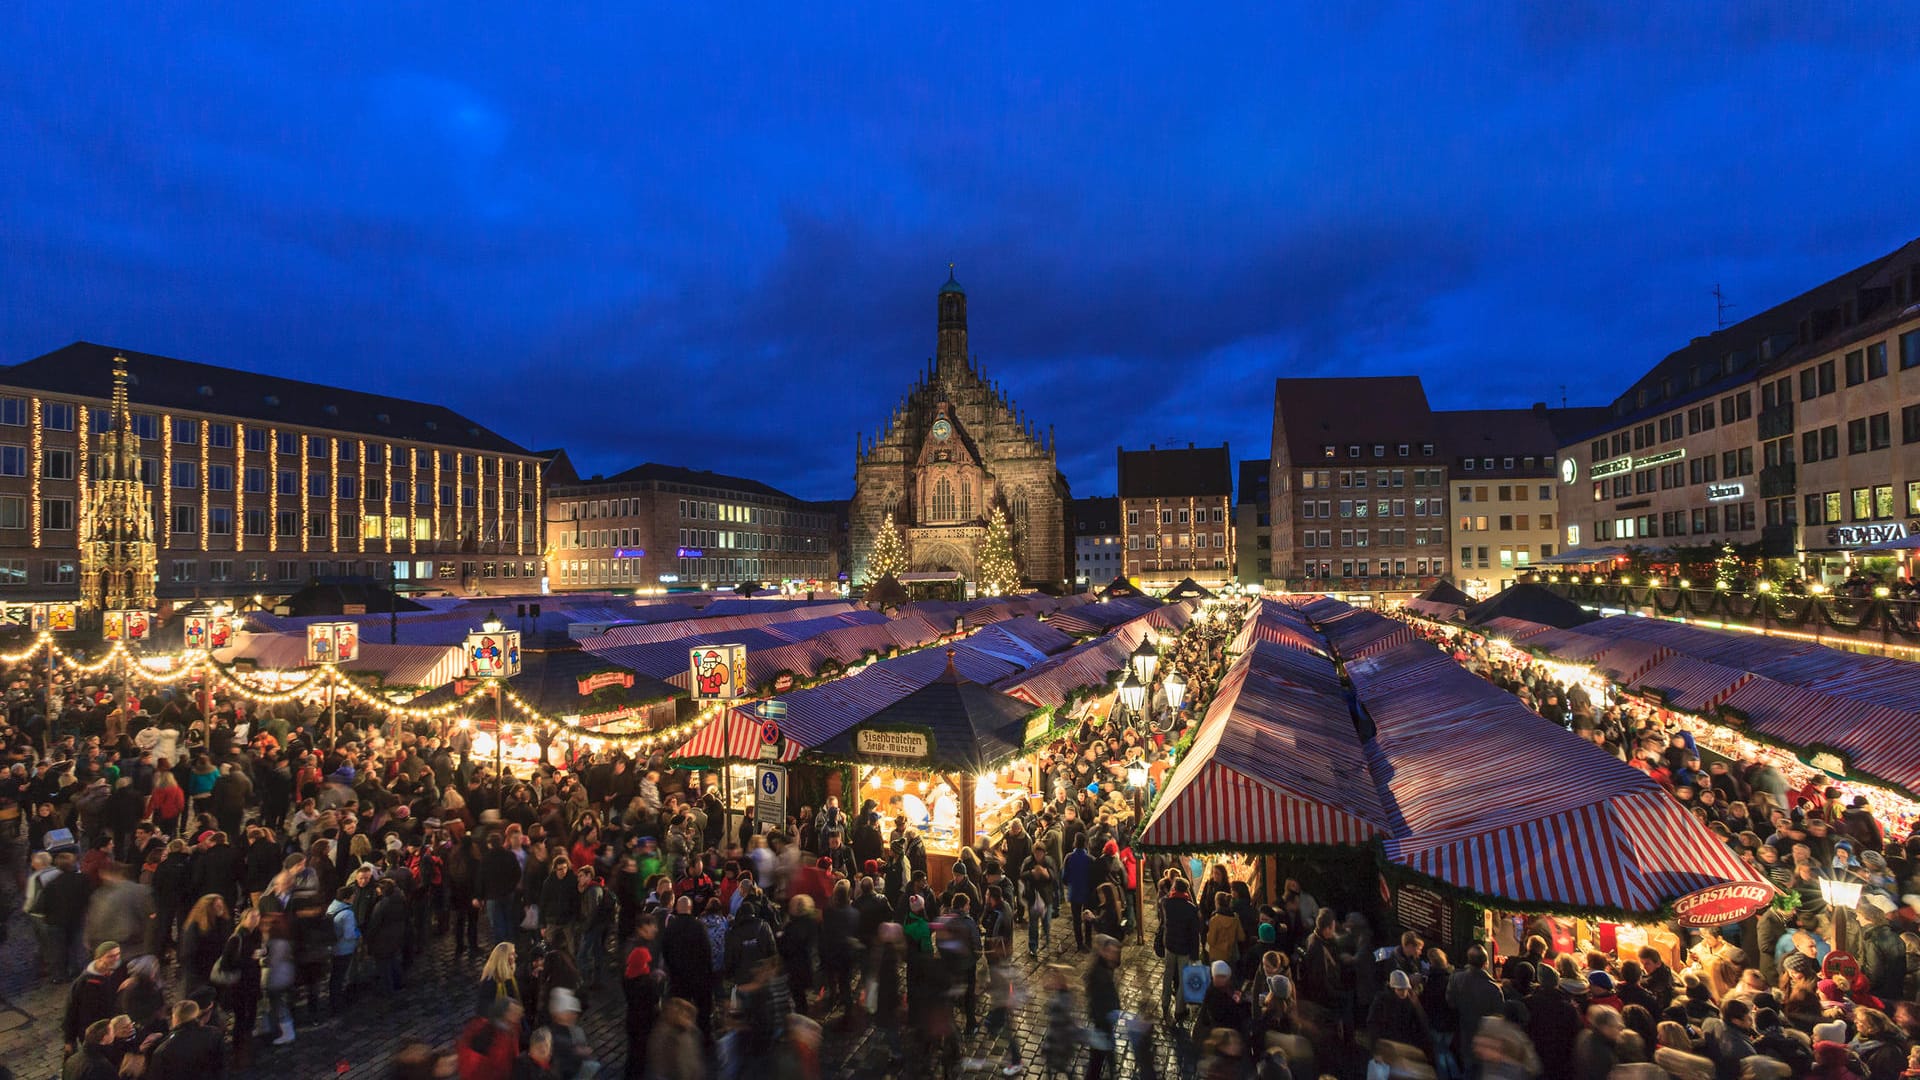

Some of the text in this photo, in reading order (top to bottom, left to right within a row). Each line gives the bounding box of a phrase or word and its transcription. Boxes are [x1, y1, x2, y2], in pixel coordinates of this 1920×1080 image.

[862, 731, 922, 746] Fischbrötchen
[1676, 885, 1767, 913] GERSTACKER
[1689, 906, 1747, 923] GLÜHWEIN
